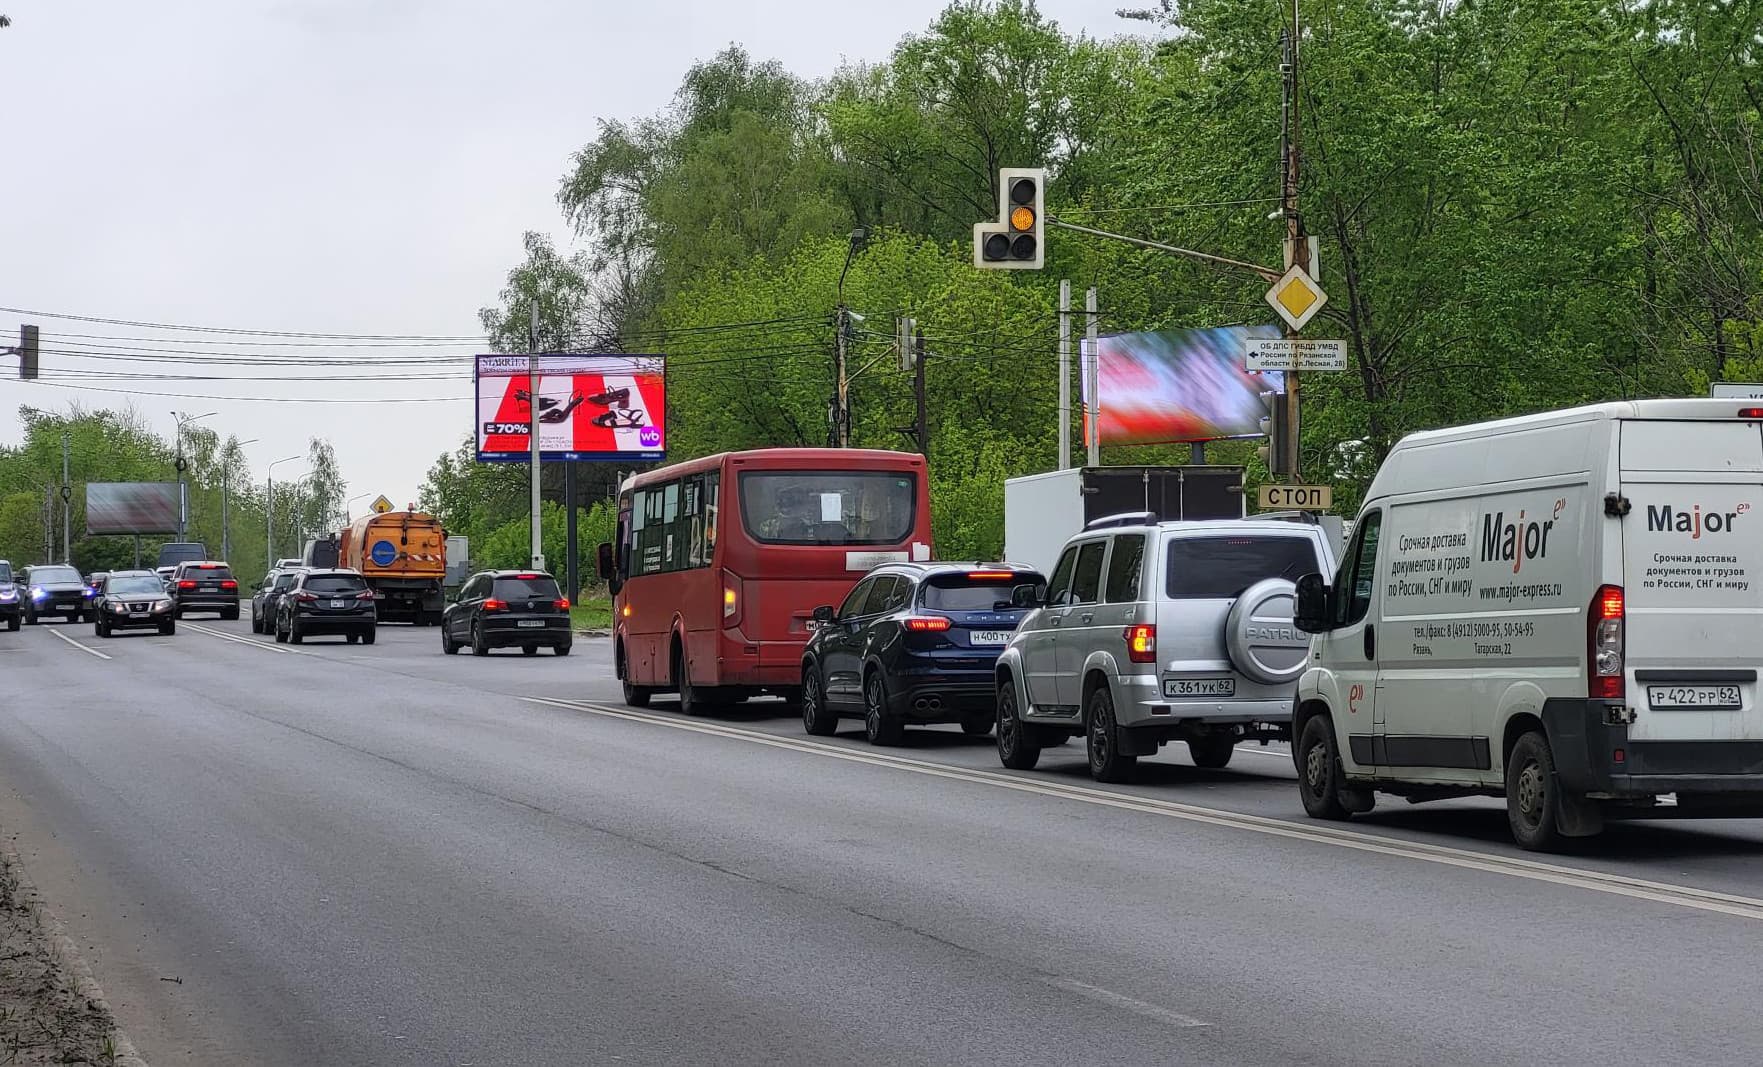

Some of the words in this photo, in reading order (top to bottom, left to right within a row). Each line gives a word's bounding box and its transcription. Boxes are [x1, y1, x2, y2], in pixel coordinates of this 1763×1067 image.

[641, 430, 660, 441] wb
[1268, 488, 1321, 505] СТОП
[1647, 505, 1737, 539] Major
[1400, 534, 1430, 554] Срочная
[1431, 533, 1466, 552] доставка
[1481, 510, 1553, 573] Major
[1392, 559, 1435, 577] документов
[1438, 558, 1443, 571] и
[1445, 556, 1470, 575] грузов
[1653, 553, 1692, 564] Срочная
[1695, 555, 1737, 564] доставка
[1647, 568, 1702, 577] документов
[1713, 568, 1745, 577] грузов
[1388, 584, 1397, 596] по
[1399, 580, 1426, 597] России,
[1429, 577, 1443, 594] СНГ
[1445, 581, 1449, 594] и
[1452, 579, 1472, 597] миру
[1479, 581, 1562, 603] www.major-express.ru
[1643, 580, 1655, 588] по
[1657, 579, 1694, 590] России,
[1696, 579, 1714, 588] СНГ
[1725, 581, 1749, 590] миру
[1245, 627, 1306, 641] PATRIO
[1447, 624, 1452, 637] 8
[1453, 622, 1473, 639] (4912)
[1504, 622, 1534, 637] 50-54-95
[1504, 643, 1512, 655] 22
[1720, 688, 1735, 699] 62
